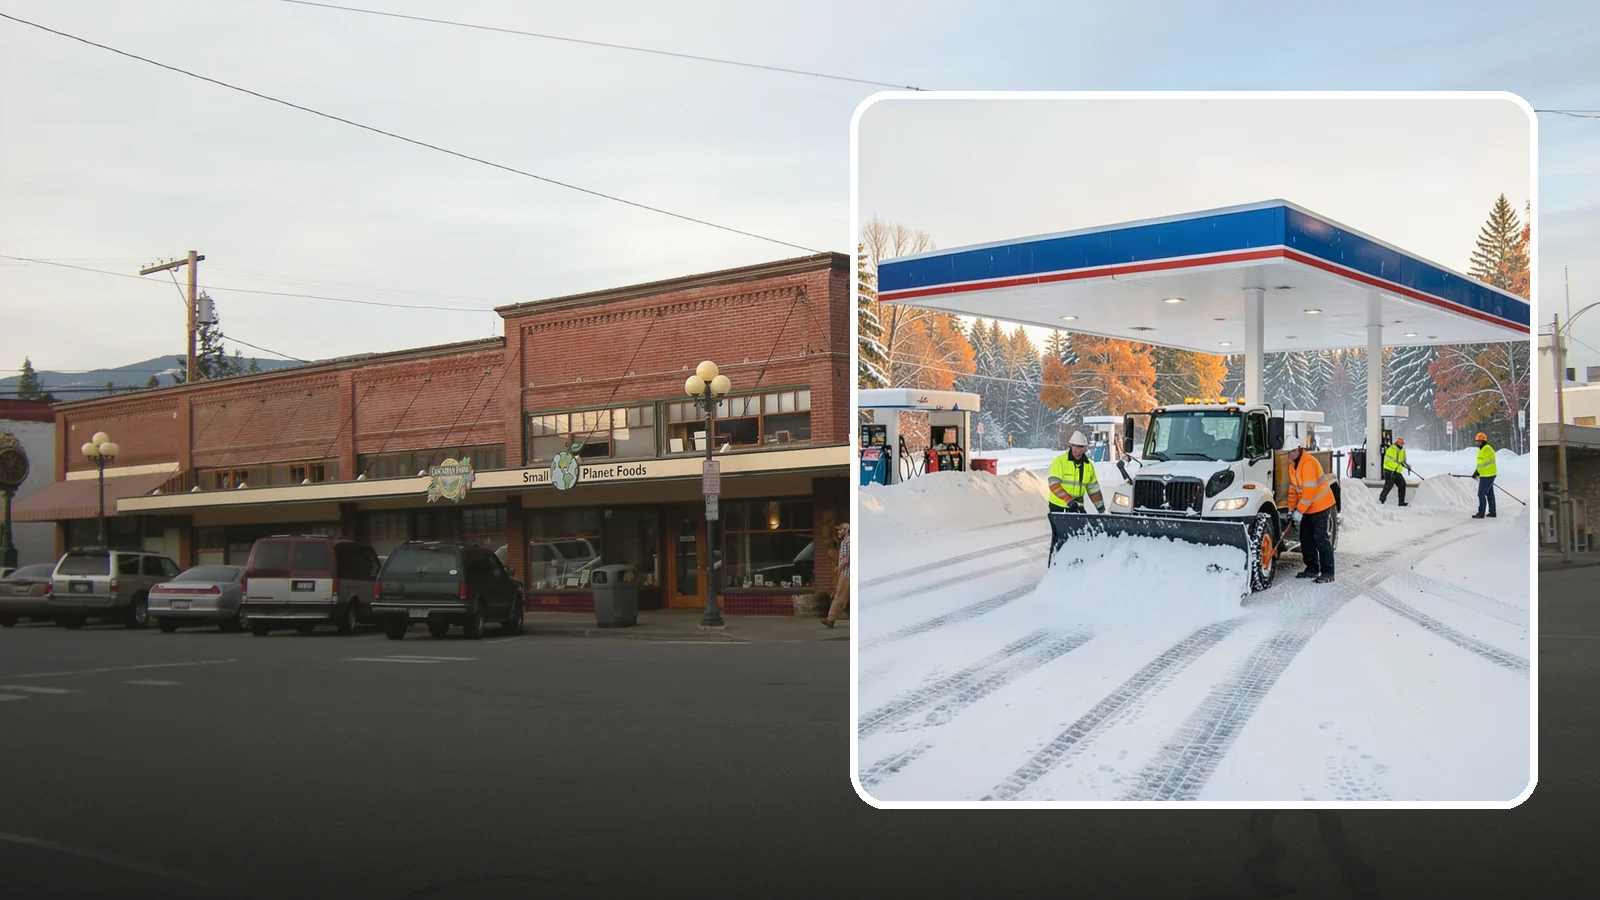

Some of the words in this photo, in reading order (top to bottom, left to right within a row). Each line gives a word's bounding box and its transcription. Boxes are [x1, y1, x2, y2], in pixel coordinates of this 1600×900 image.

[523, 471, 549, 483] Small
[582, 467, 614, 479] Planet
[617, 464, 647, 477] Foods
